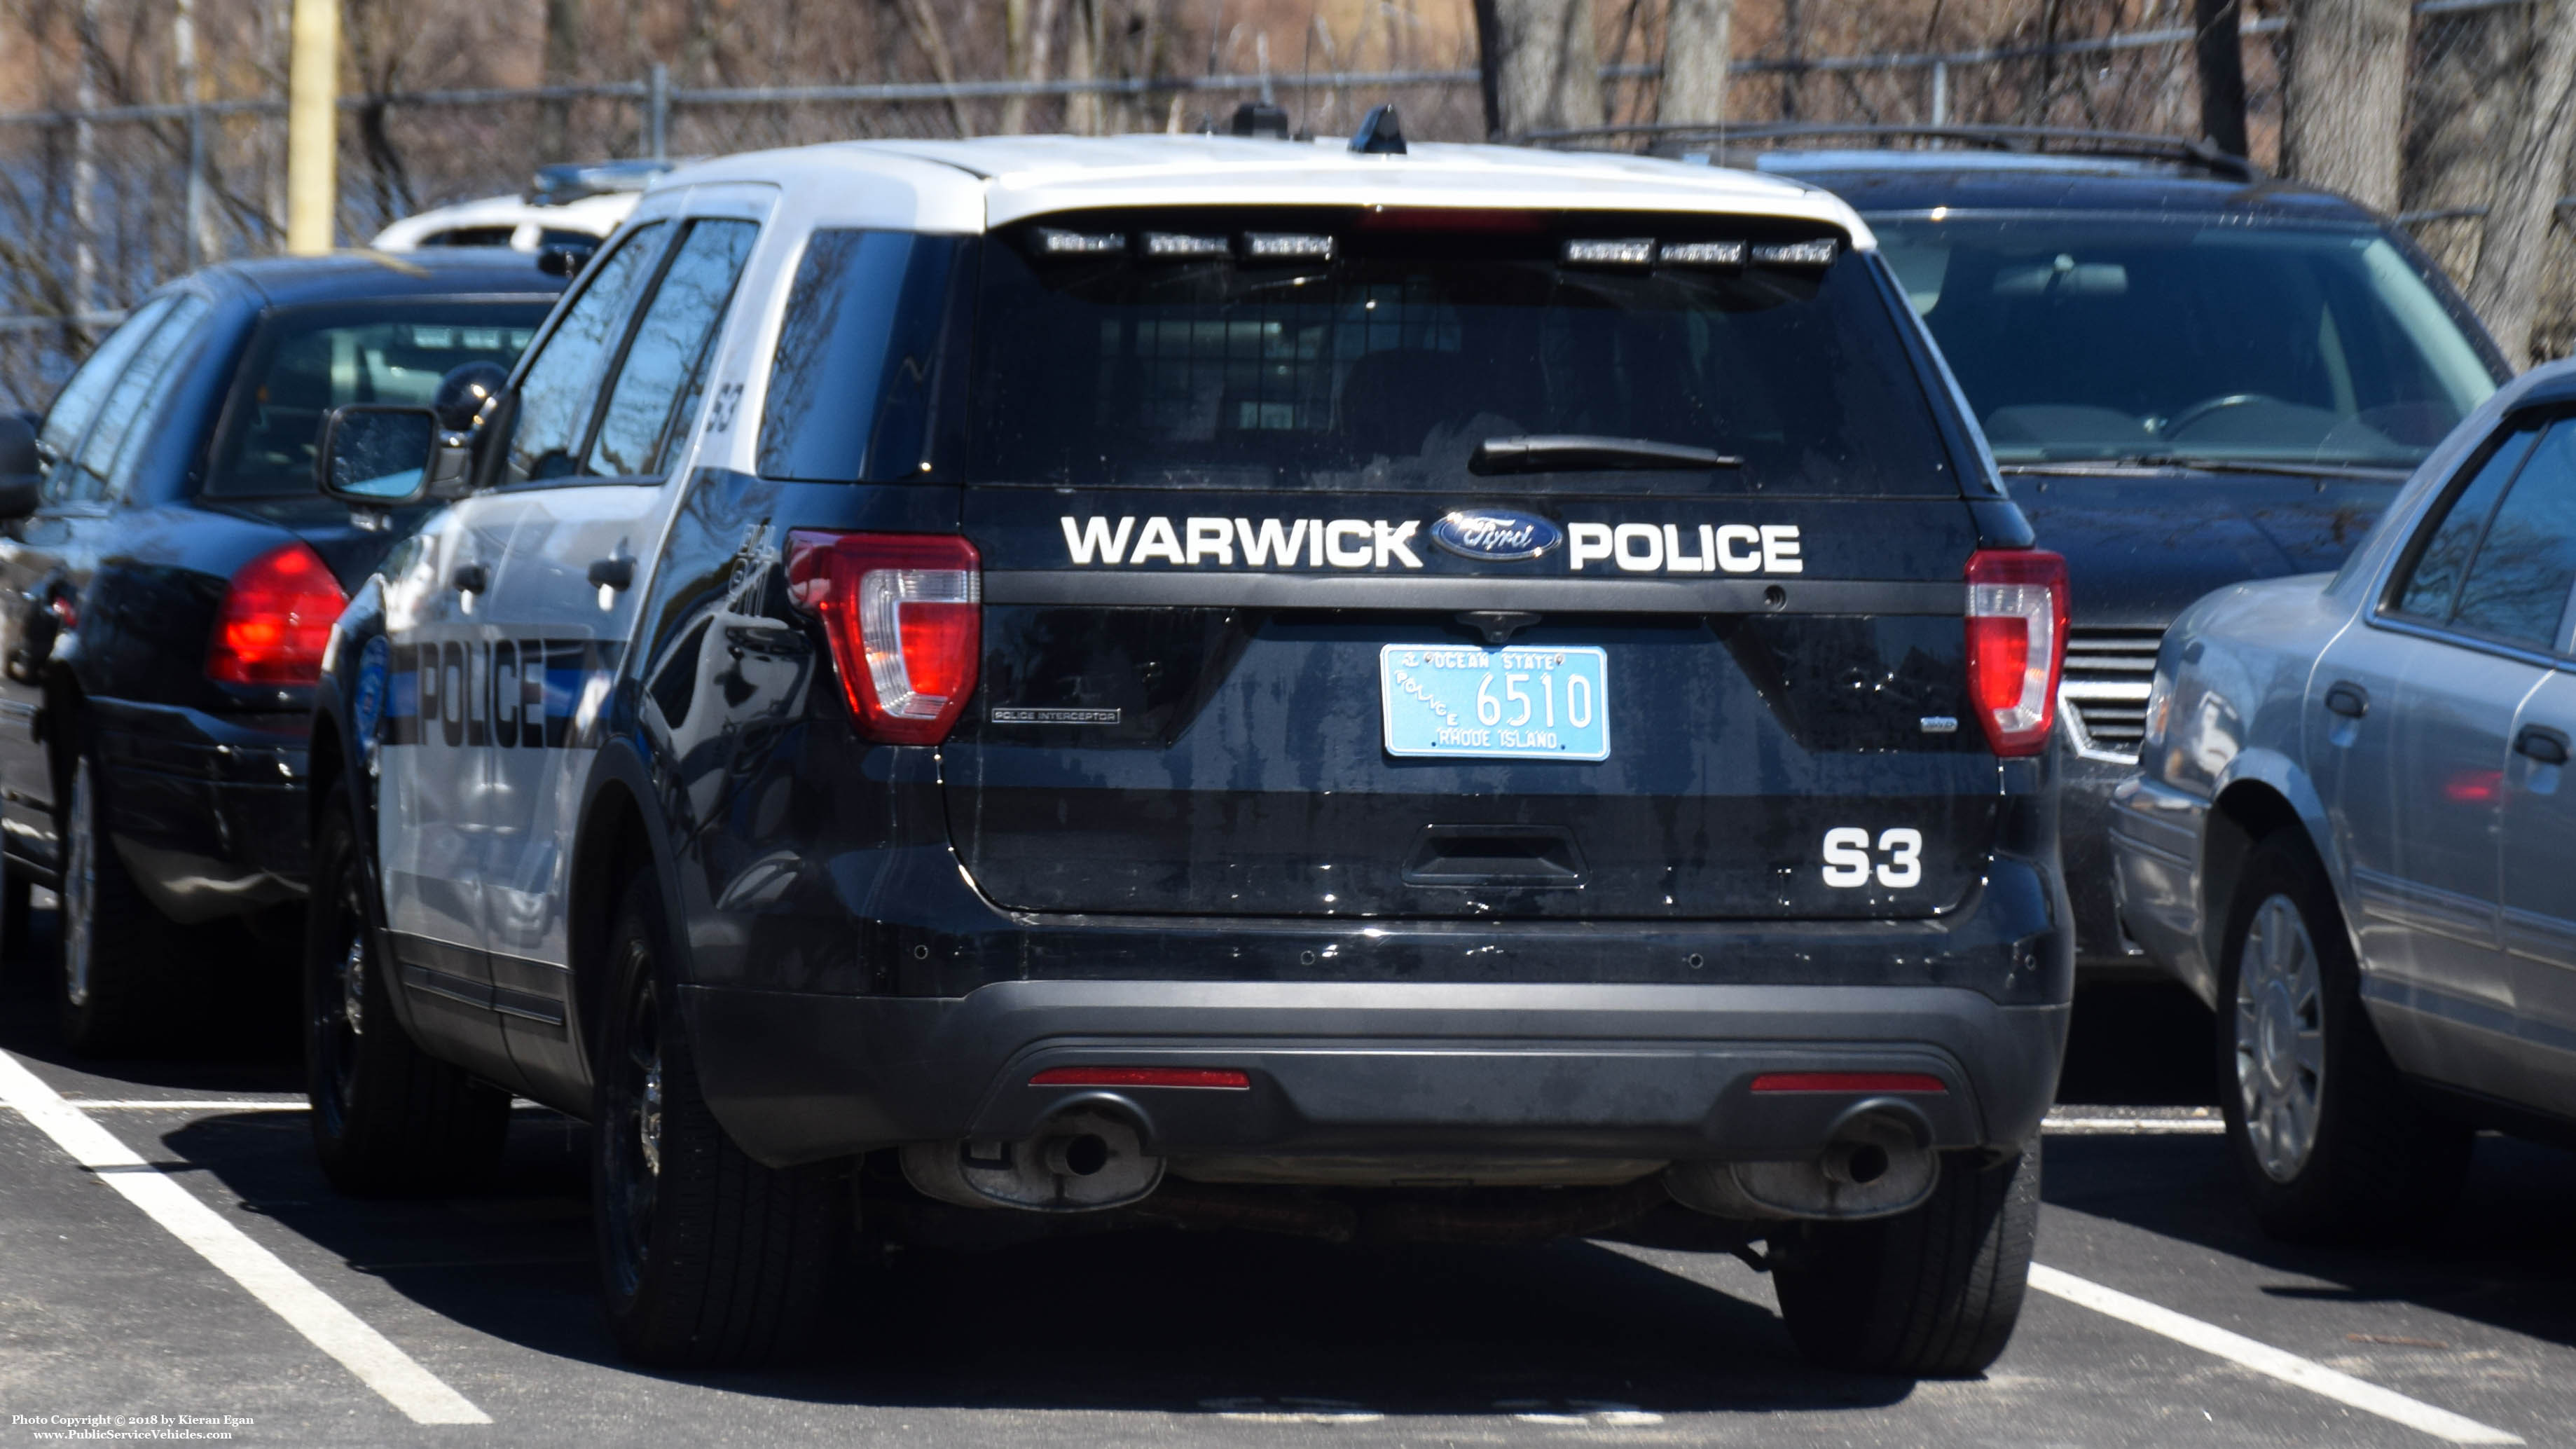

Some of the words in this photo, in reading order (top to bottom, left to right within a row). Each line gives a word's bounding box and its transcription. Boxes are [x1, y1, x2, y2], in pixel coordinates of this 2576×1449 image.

[1061, 516, 1424, 568] WARWICK
[1463, 517, 1534, 551] Ford
[1568, 523, 1803, 573] POLICE
[1433, 652, 1489, 668] OCEAN
[1502, 652, 1555, 670] STATE
[420, 639, 546, 748] POLICE
[995, 711, 1035, 720] POLICE
[1038, 712, 1116, 721] INTERCEPTOR
[1394, 670, 1459, 726] POLICE
[1476, 672, 1592, 729] 6510
[1437, 728, 1491, 747] RHODE
[1498, 730, 1557, 749] ISLAND
[1822, 827, 1922, 888] S3
